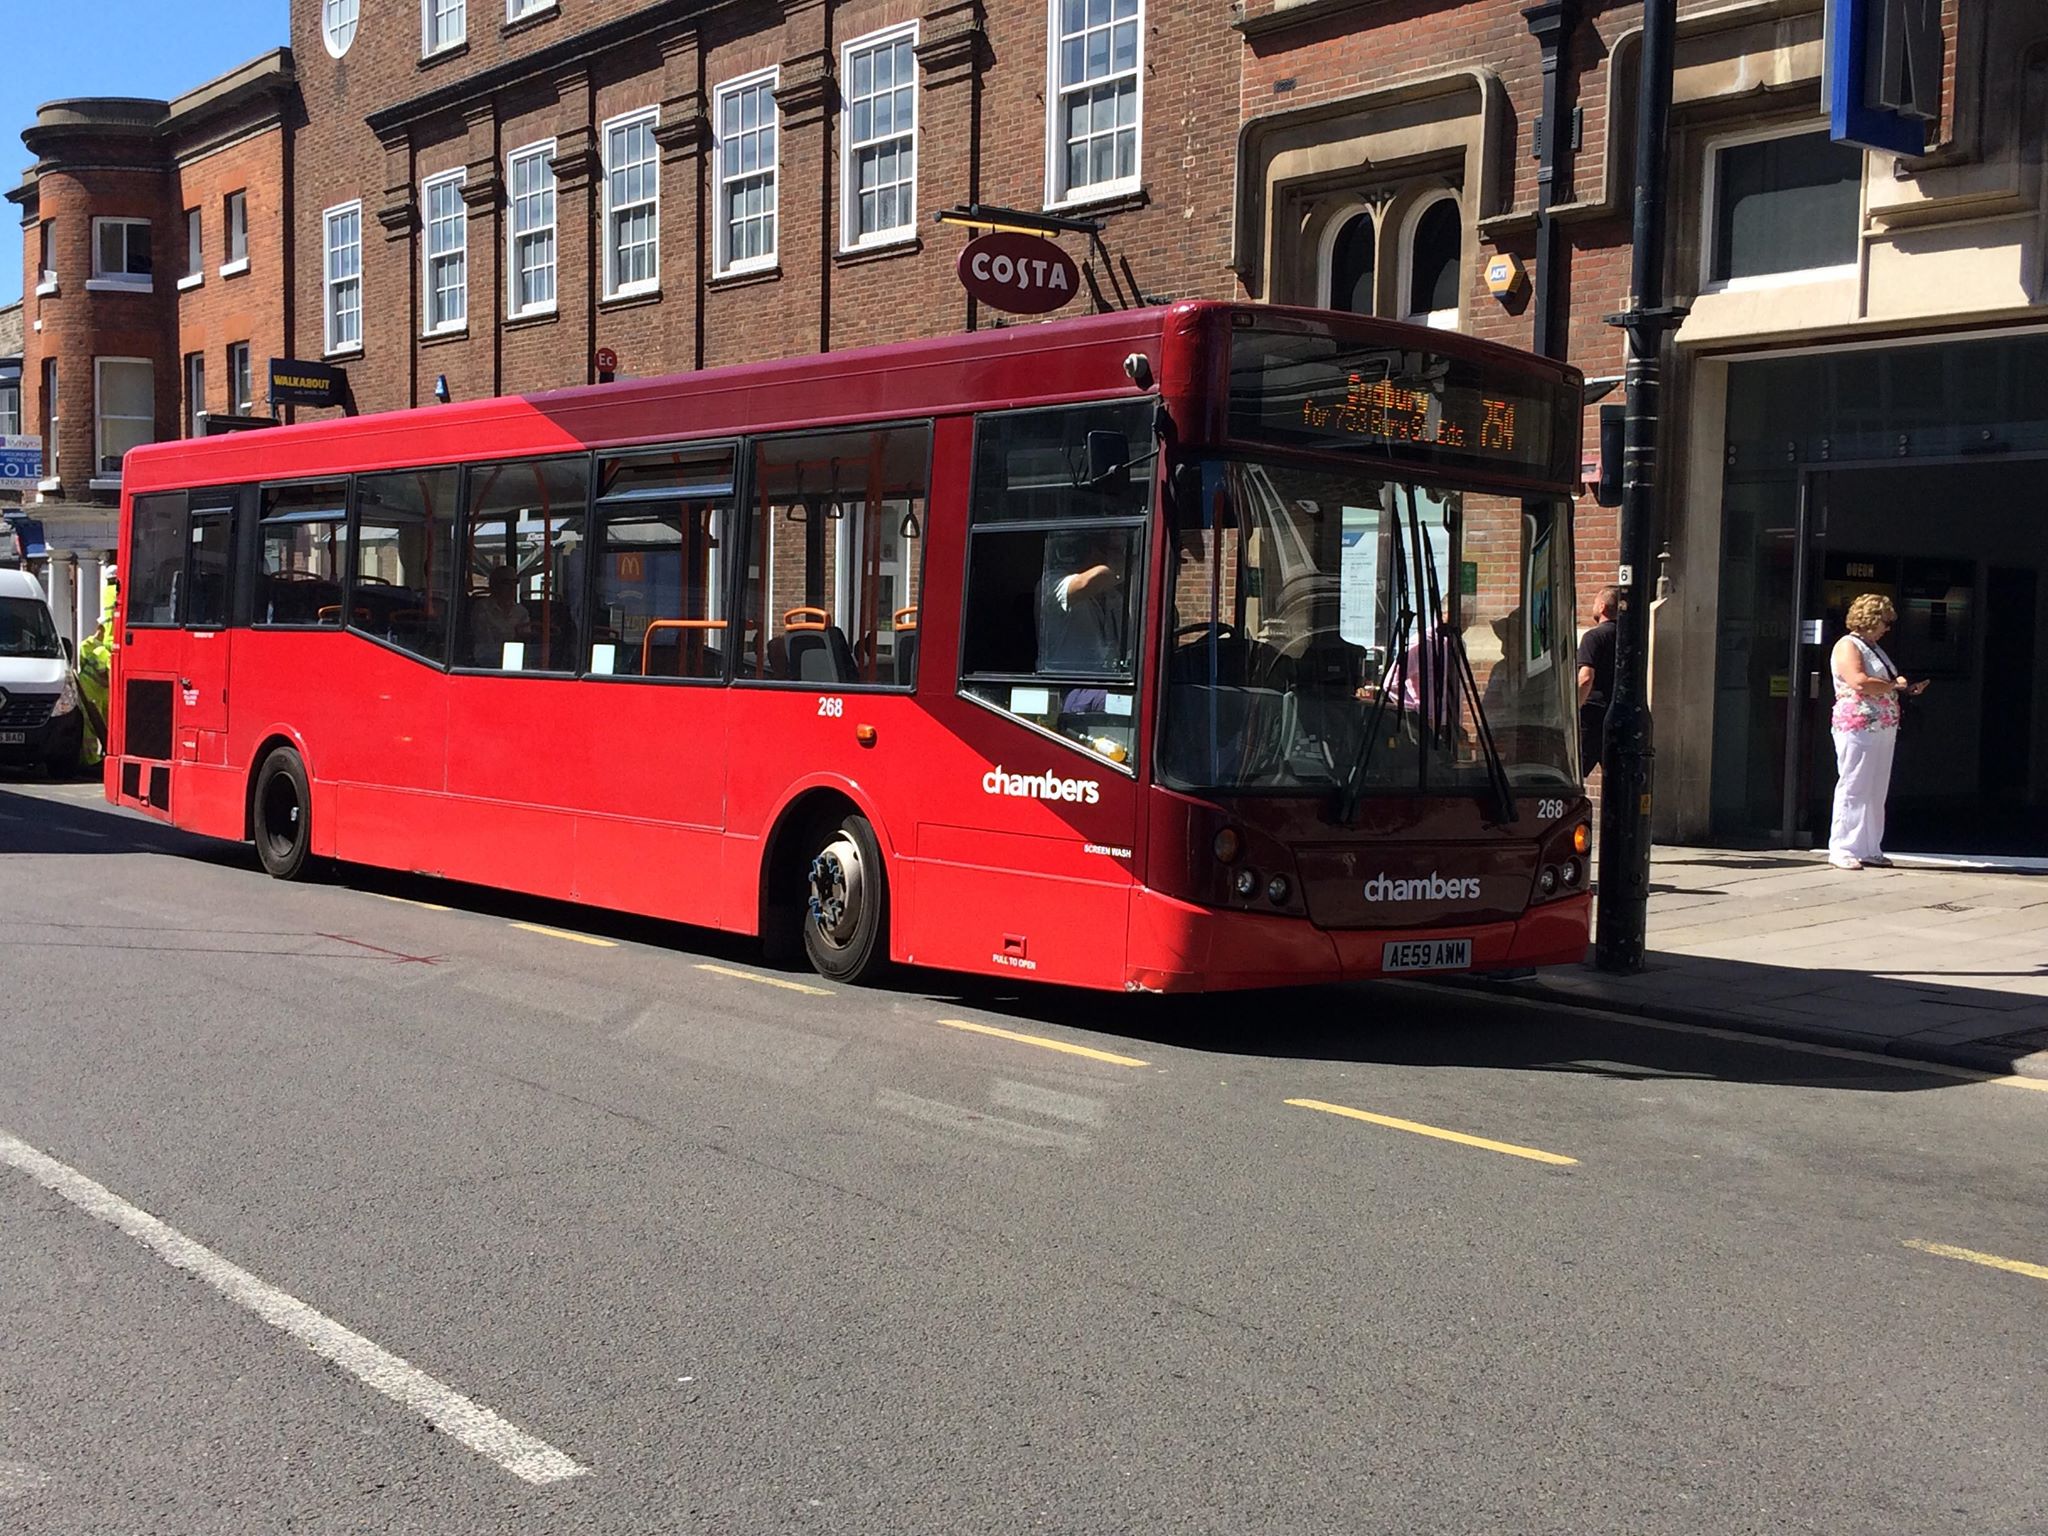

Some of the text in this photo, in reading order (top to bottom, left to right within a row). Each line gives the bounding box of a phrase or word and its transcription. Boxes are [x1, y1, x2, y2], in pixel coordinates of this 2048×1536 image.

[972, 252, 1068, 290] COSTA
[273, 374, 330, 390] WALKABOUT
[1347, 372, 1429, 414] Sudbury
[1304, 399, 1331, 426] for
[1481, 398, 1515, 450] 75A
[1621, 570, 1628, 581] 6
[818, 697, 843, 717] 268
[982, 764, 1100, 804] chambers
[1537, 799, 1563, 819] 268
[1084, 843, 1132, 858] SCREEN WASH
[1364, 870, 1481, 902] chambers
[992, 953, 1036, 970] PULL TO OPEN
[1389, 942, 1466, 968] AE59 AWM
